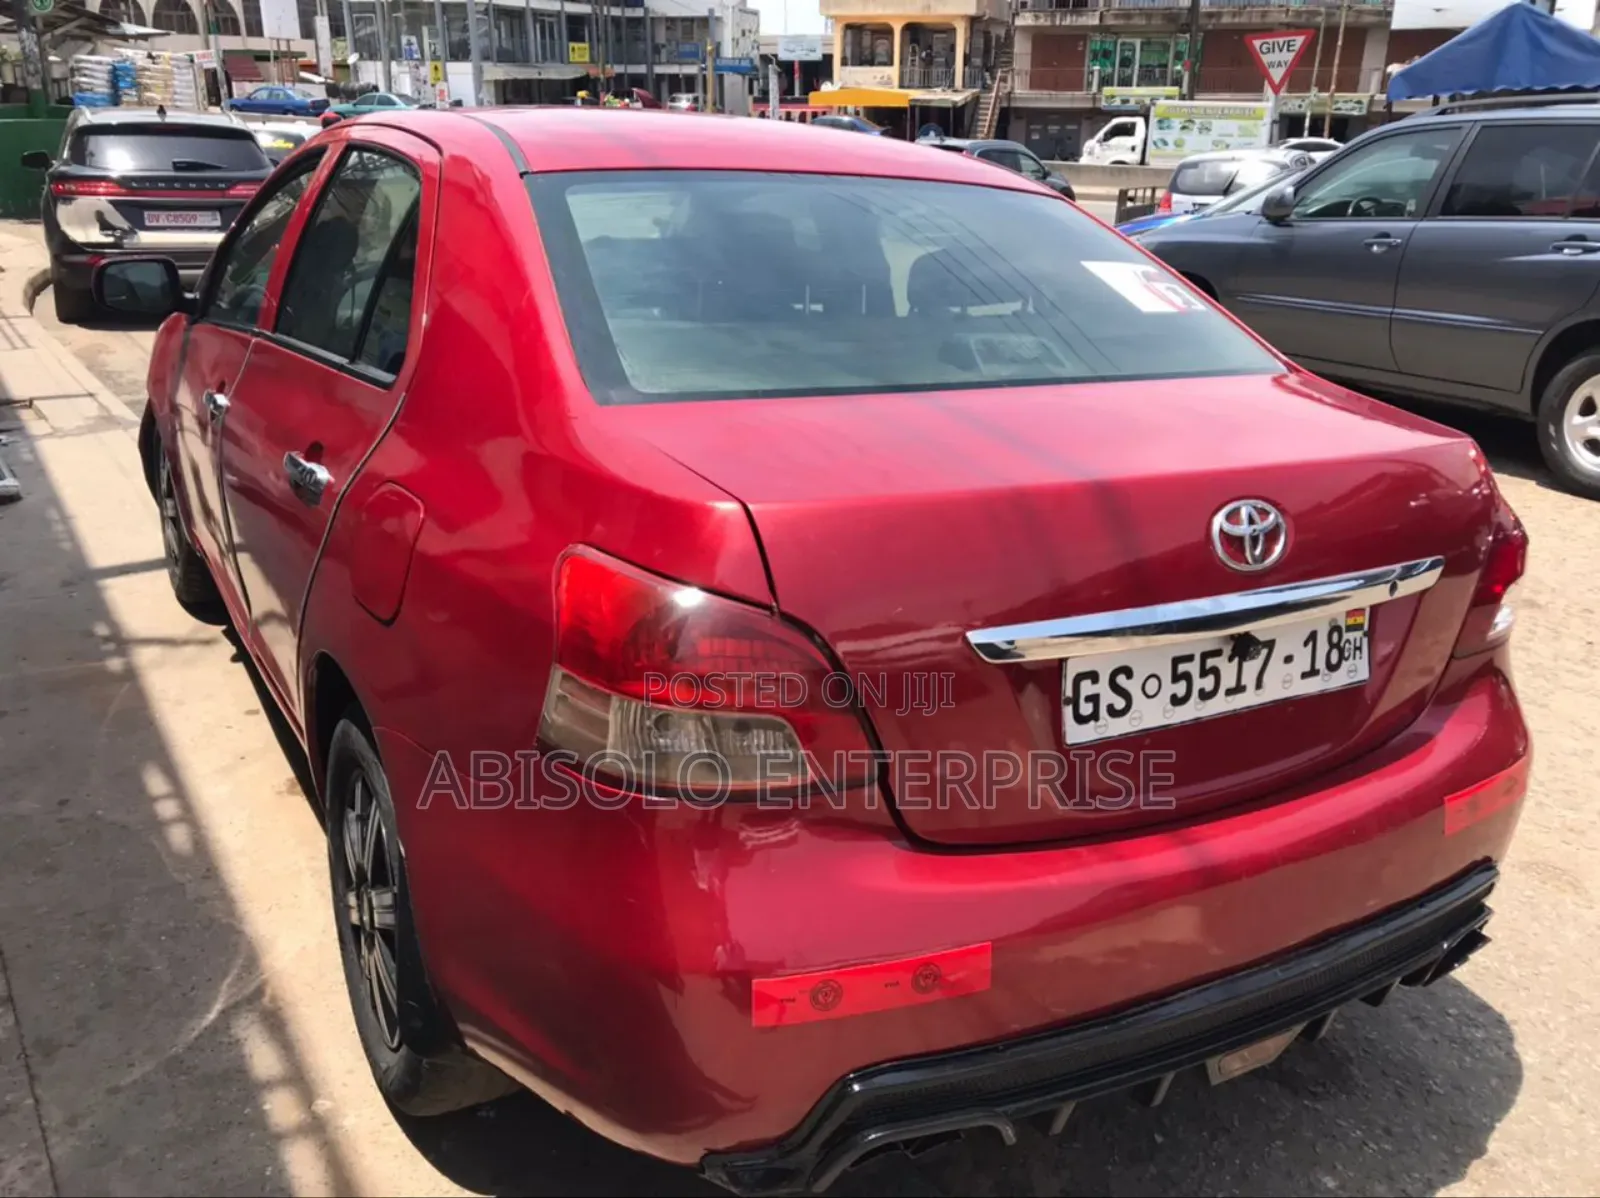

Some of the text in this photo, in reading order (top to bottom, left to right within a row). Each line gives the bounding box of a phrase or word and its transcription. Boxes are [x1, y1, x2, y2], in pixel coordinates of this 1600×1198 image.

[1259, 39, 1297, 55] GIVE
[1267, 60, 1289, 69] WAY
[1342, 636, 1363, 662] GH
